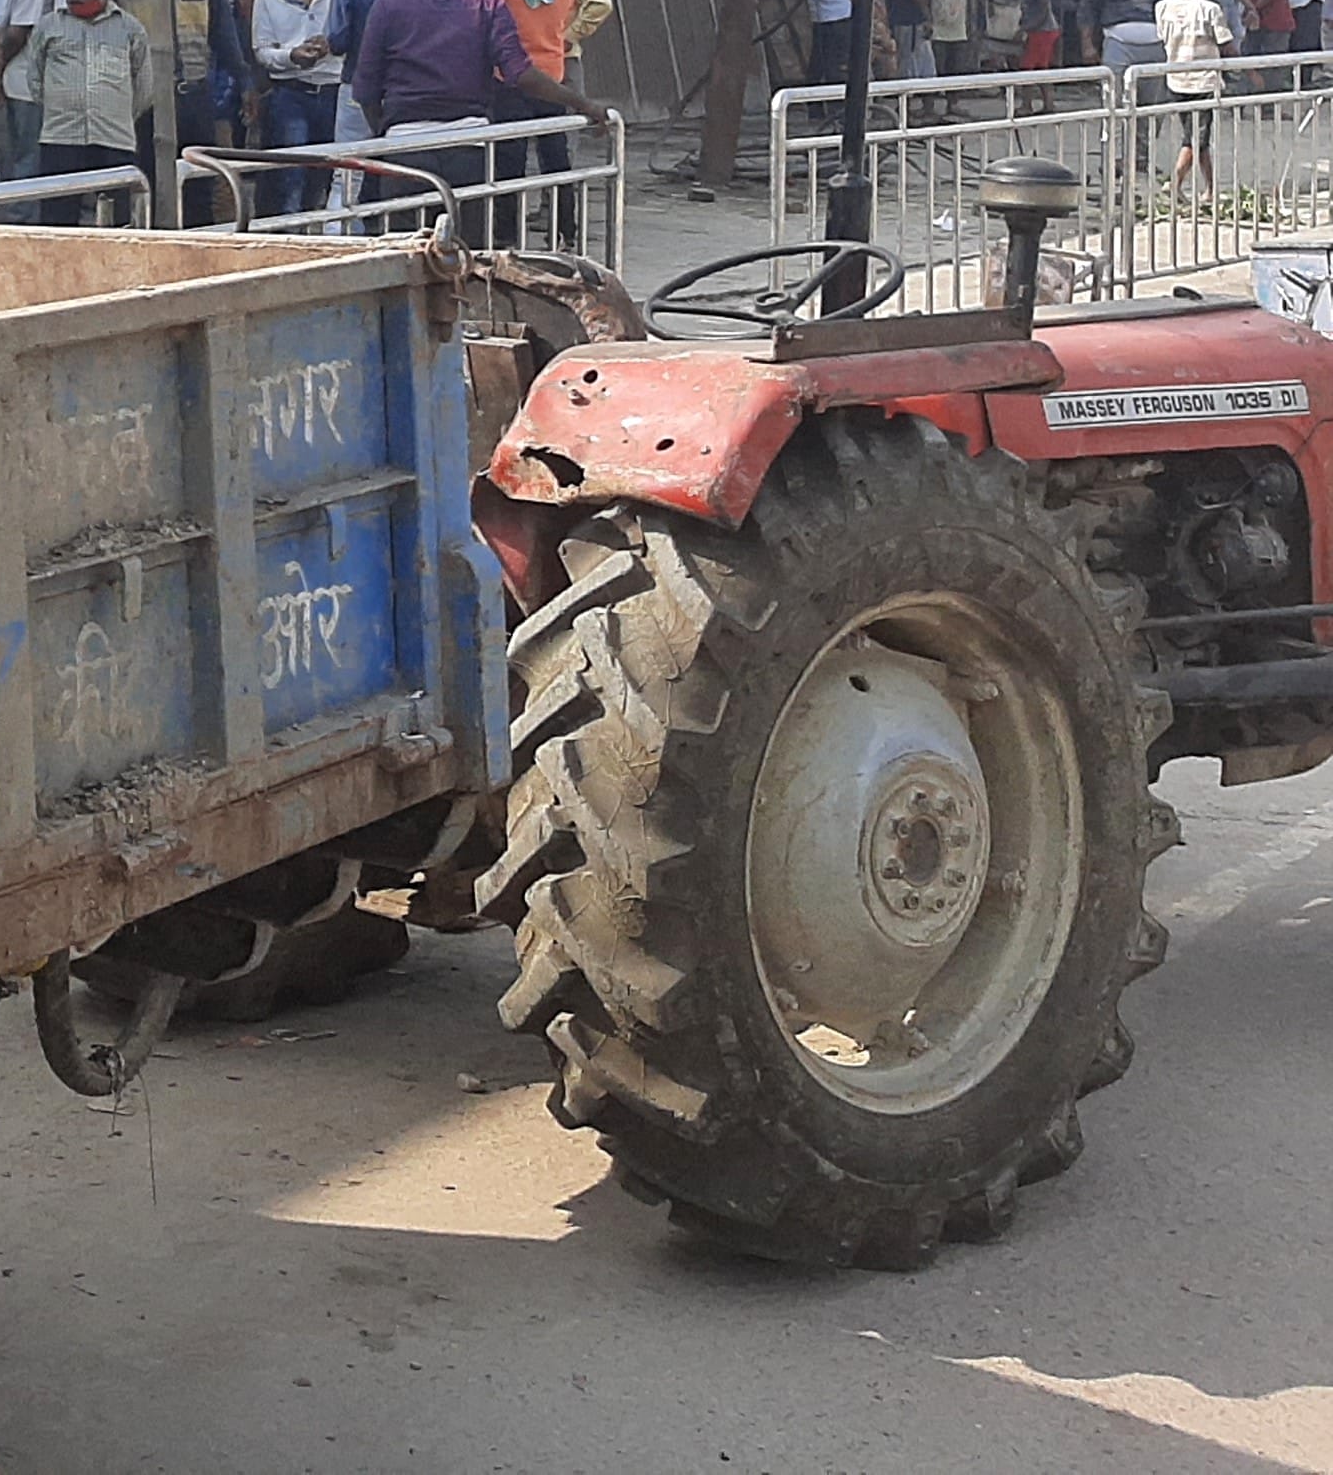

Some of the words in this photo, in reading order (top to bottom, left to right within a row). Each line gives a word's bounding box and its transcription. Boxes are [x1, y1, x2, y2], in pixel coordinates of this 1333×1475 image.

[247, 359, 353, 461] नगर
[1058, 398, 1127, 420] MASSEY
[1133, 394, 1216, 415] FERGUSON
[1225, 391, 1272, 410] 1035
[1281, 389, 1298, 407] DI
